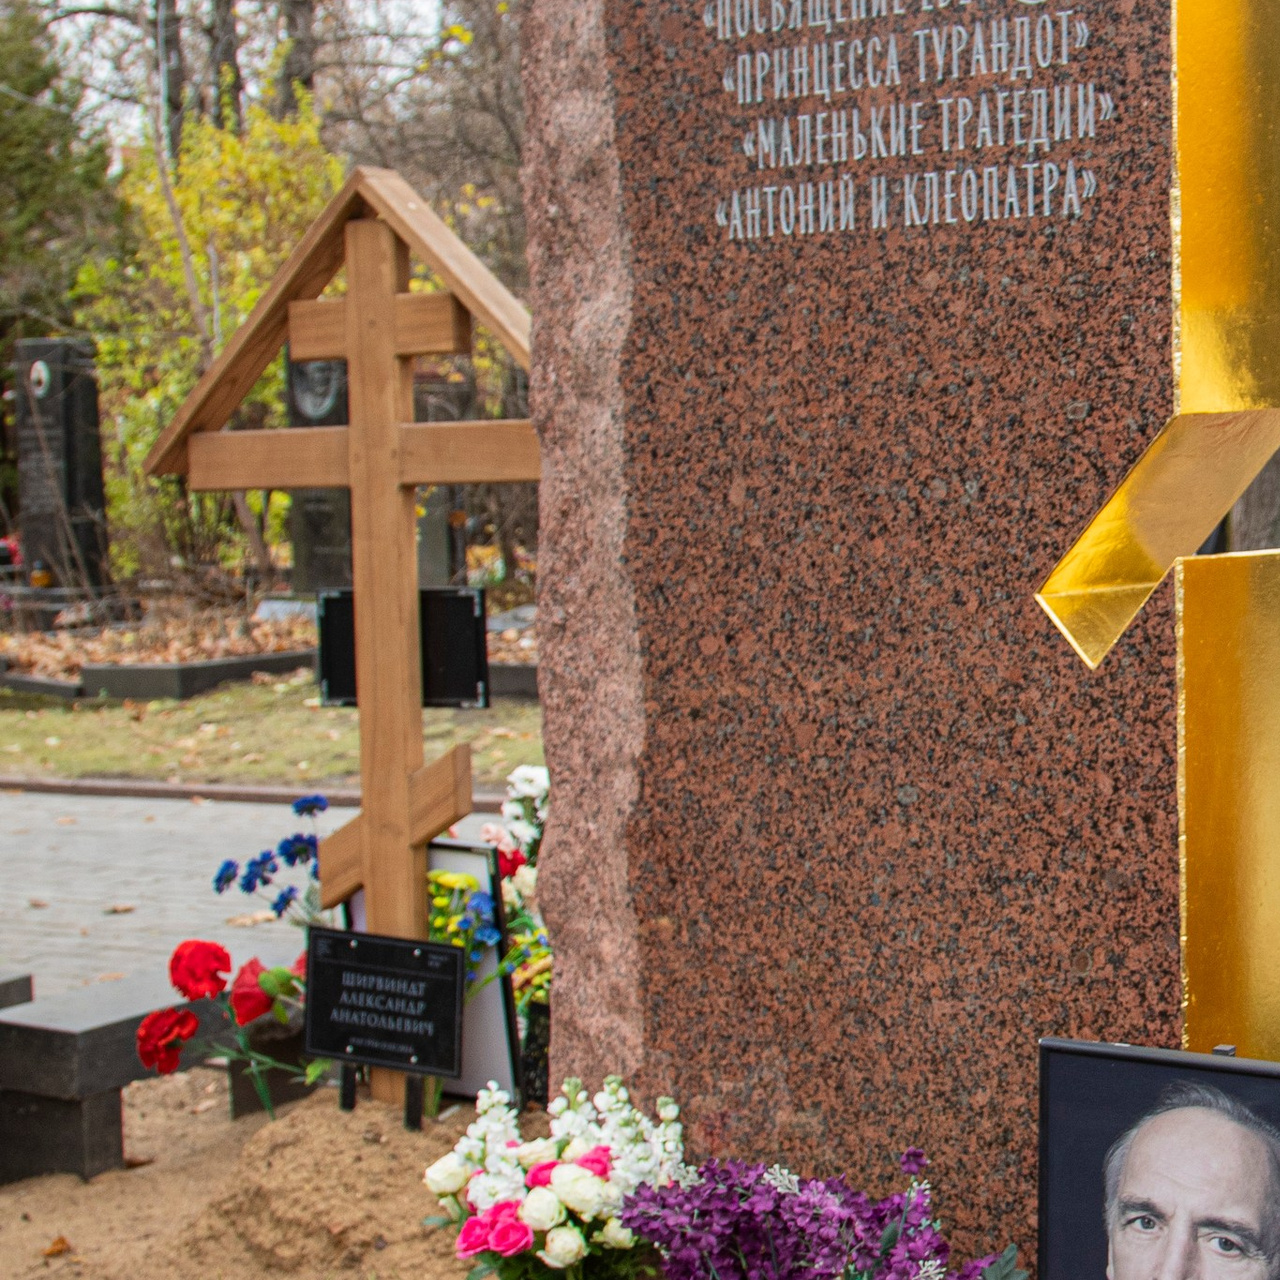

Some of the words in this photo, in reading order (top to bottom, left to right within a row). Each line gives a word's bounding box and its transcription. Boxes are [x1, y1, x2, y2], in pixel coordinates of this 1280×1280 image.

[723, 30, 904, 109] «ПРИНЦЕССА
[913, 9, 1089, 83] ТУРАНДОТ»
[743, 101, 927, 169] «МАЛЕНЬКИЕ
[940, 83, 1115, 153] ТРАГЕДИИ»
[714, 172, 856, 240] «АНТОНИЙ
[871, 175, 889, 228] И
[902, 161, 1097, 225] КЛЕОПАТРА»
[339, 991, 427, 1016] АЛЕКСАНДР
[342, 971, 427, 997] ШИРВИНДТ
[330, 1008, 434, 1037] АНАТОЛЬЕВИЧ
